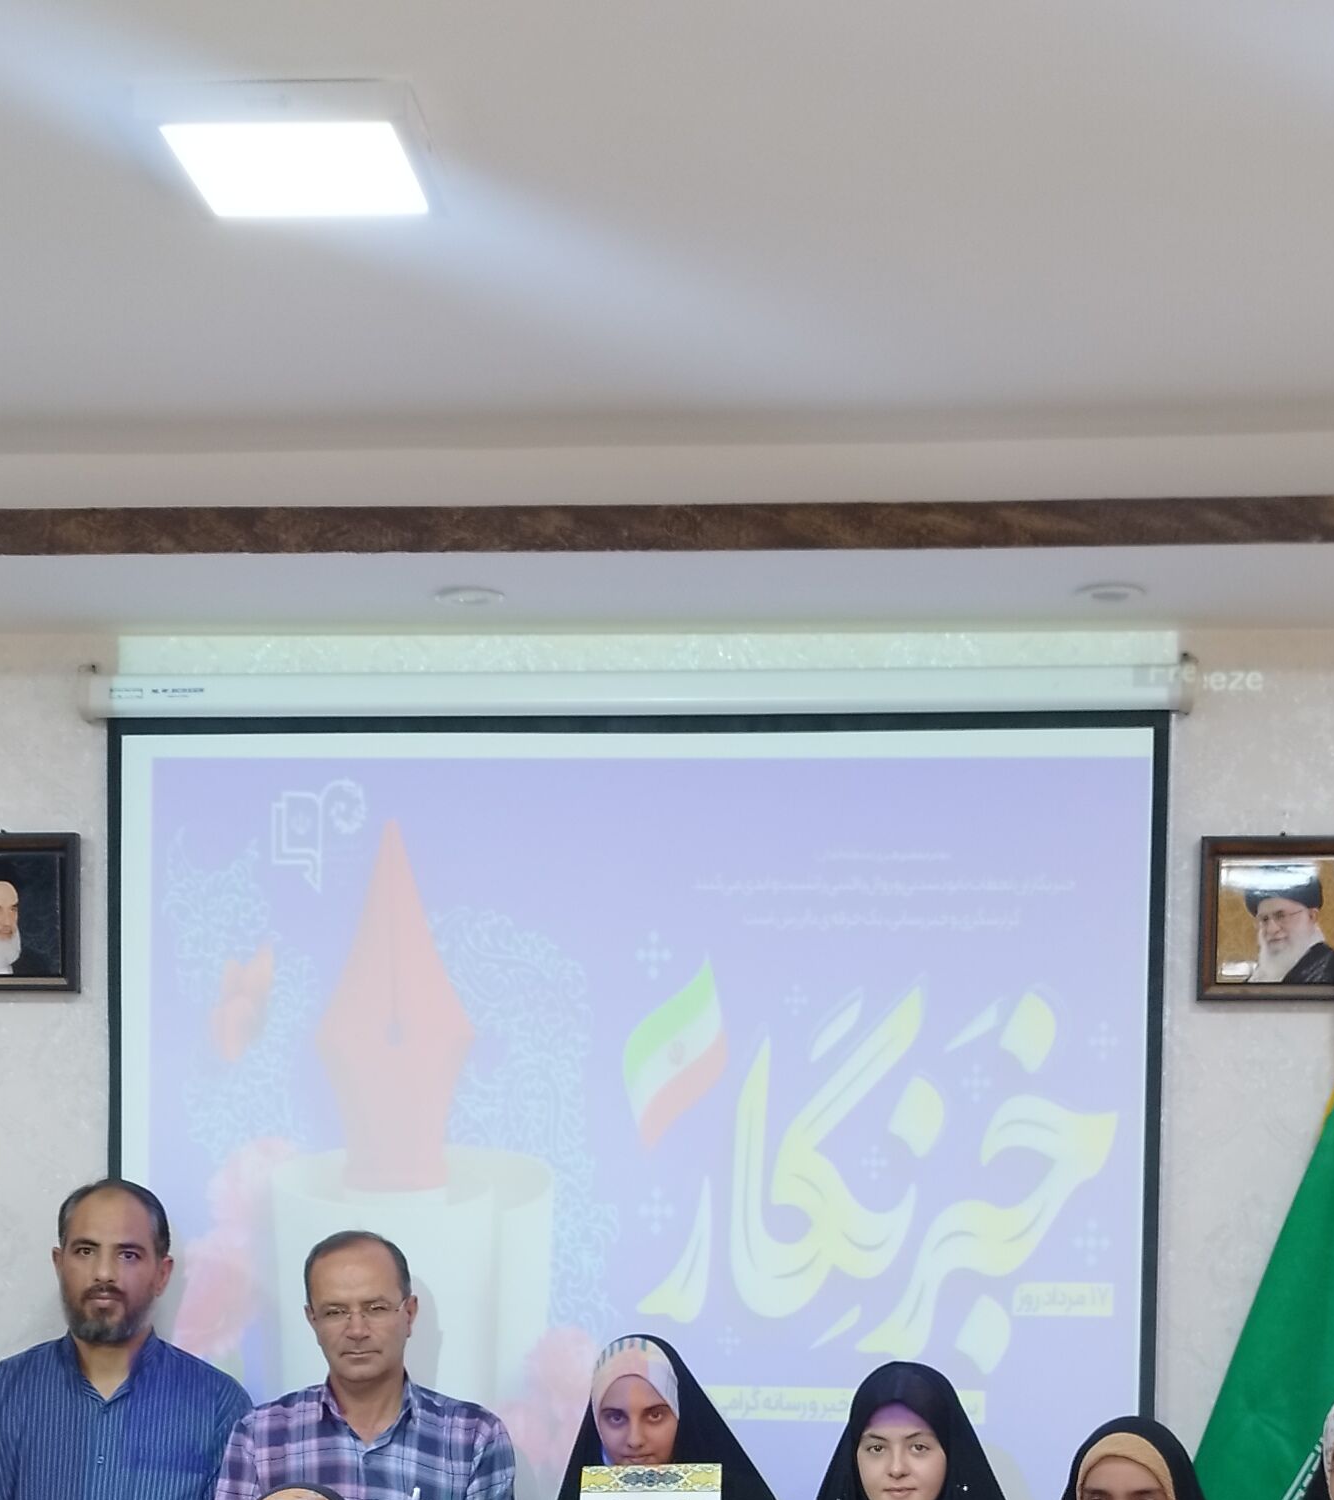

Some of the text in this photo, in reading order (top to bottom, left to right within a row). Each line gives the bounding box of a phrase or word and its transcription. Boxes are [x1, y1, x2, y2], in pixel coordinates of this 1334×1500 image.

[1148, 664, 1265, 692] Freeze
[1016, 1286, 1041, 1313] روز
[1044, 1284, 1086, 1313] مرداد
[763, 1390, 806, 1419] رسانه
